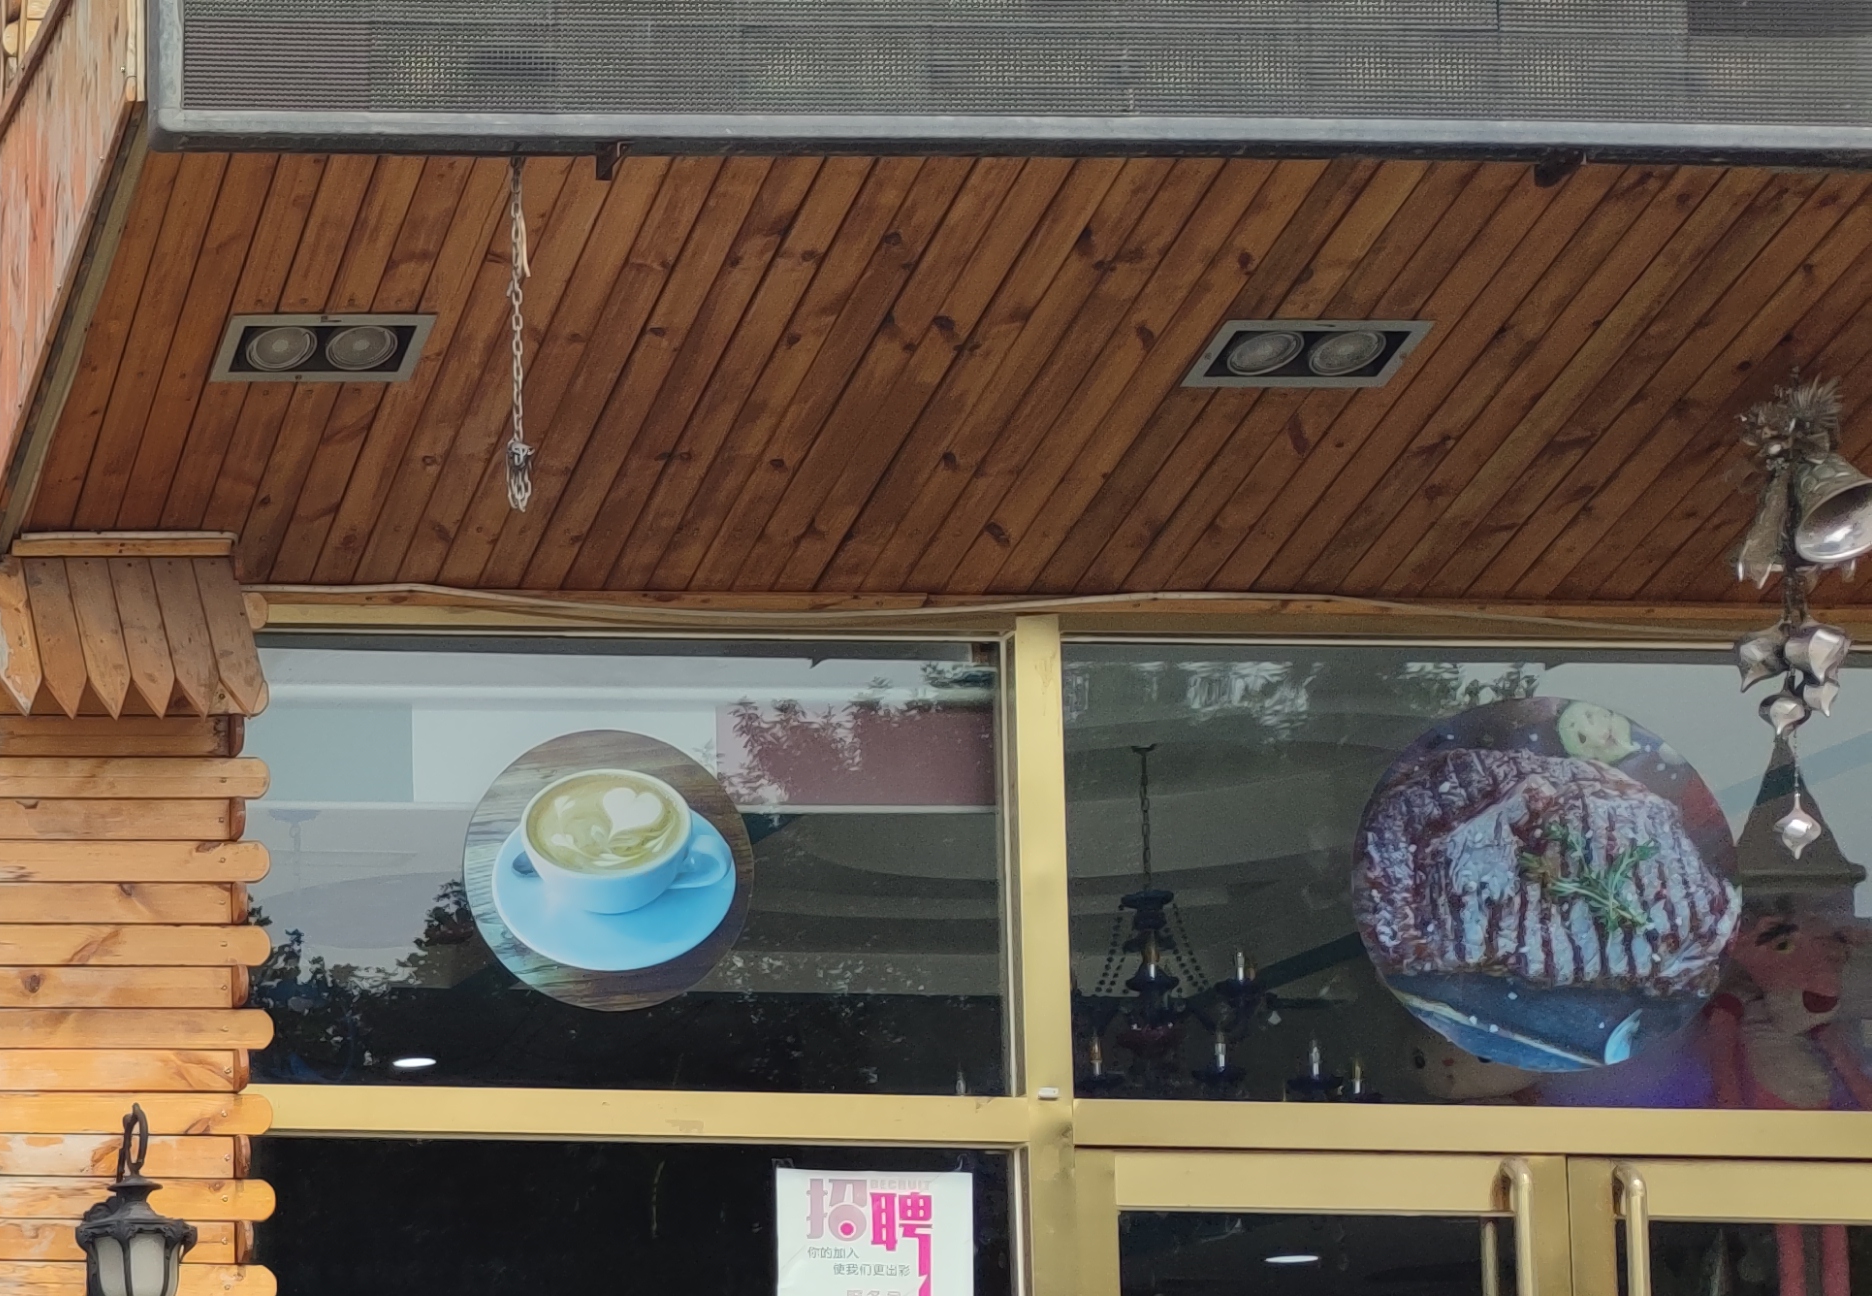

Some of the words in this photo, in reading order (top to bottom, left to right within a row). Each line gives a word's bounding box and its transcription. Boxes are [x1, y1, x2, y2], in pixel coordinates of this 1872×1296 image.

[806, 1178, 933, 1278] 招聘
[807, 1246, 859, 1259] 你的加入
[833, 1263, 910, 1277] 使我们更出彩
